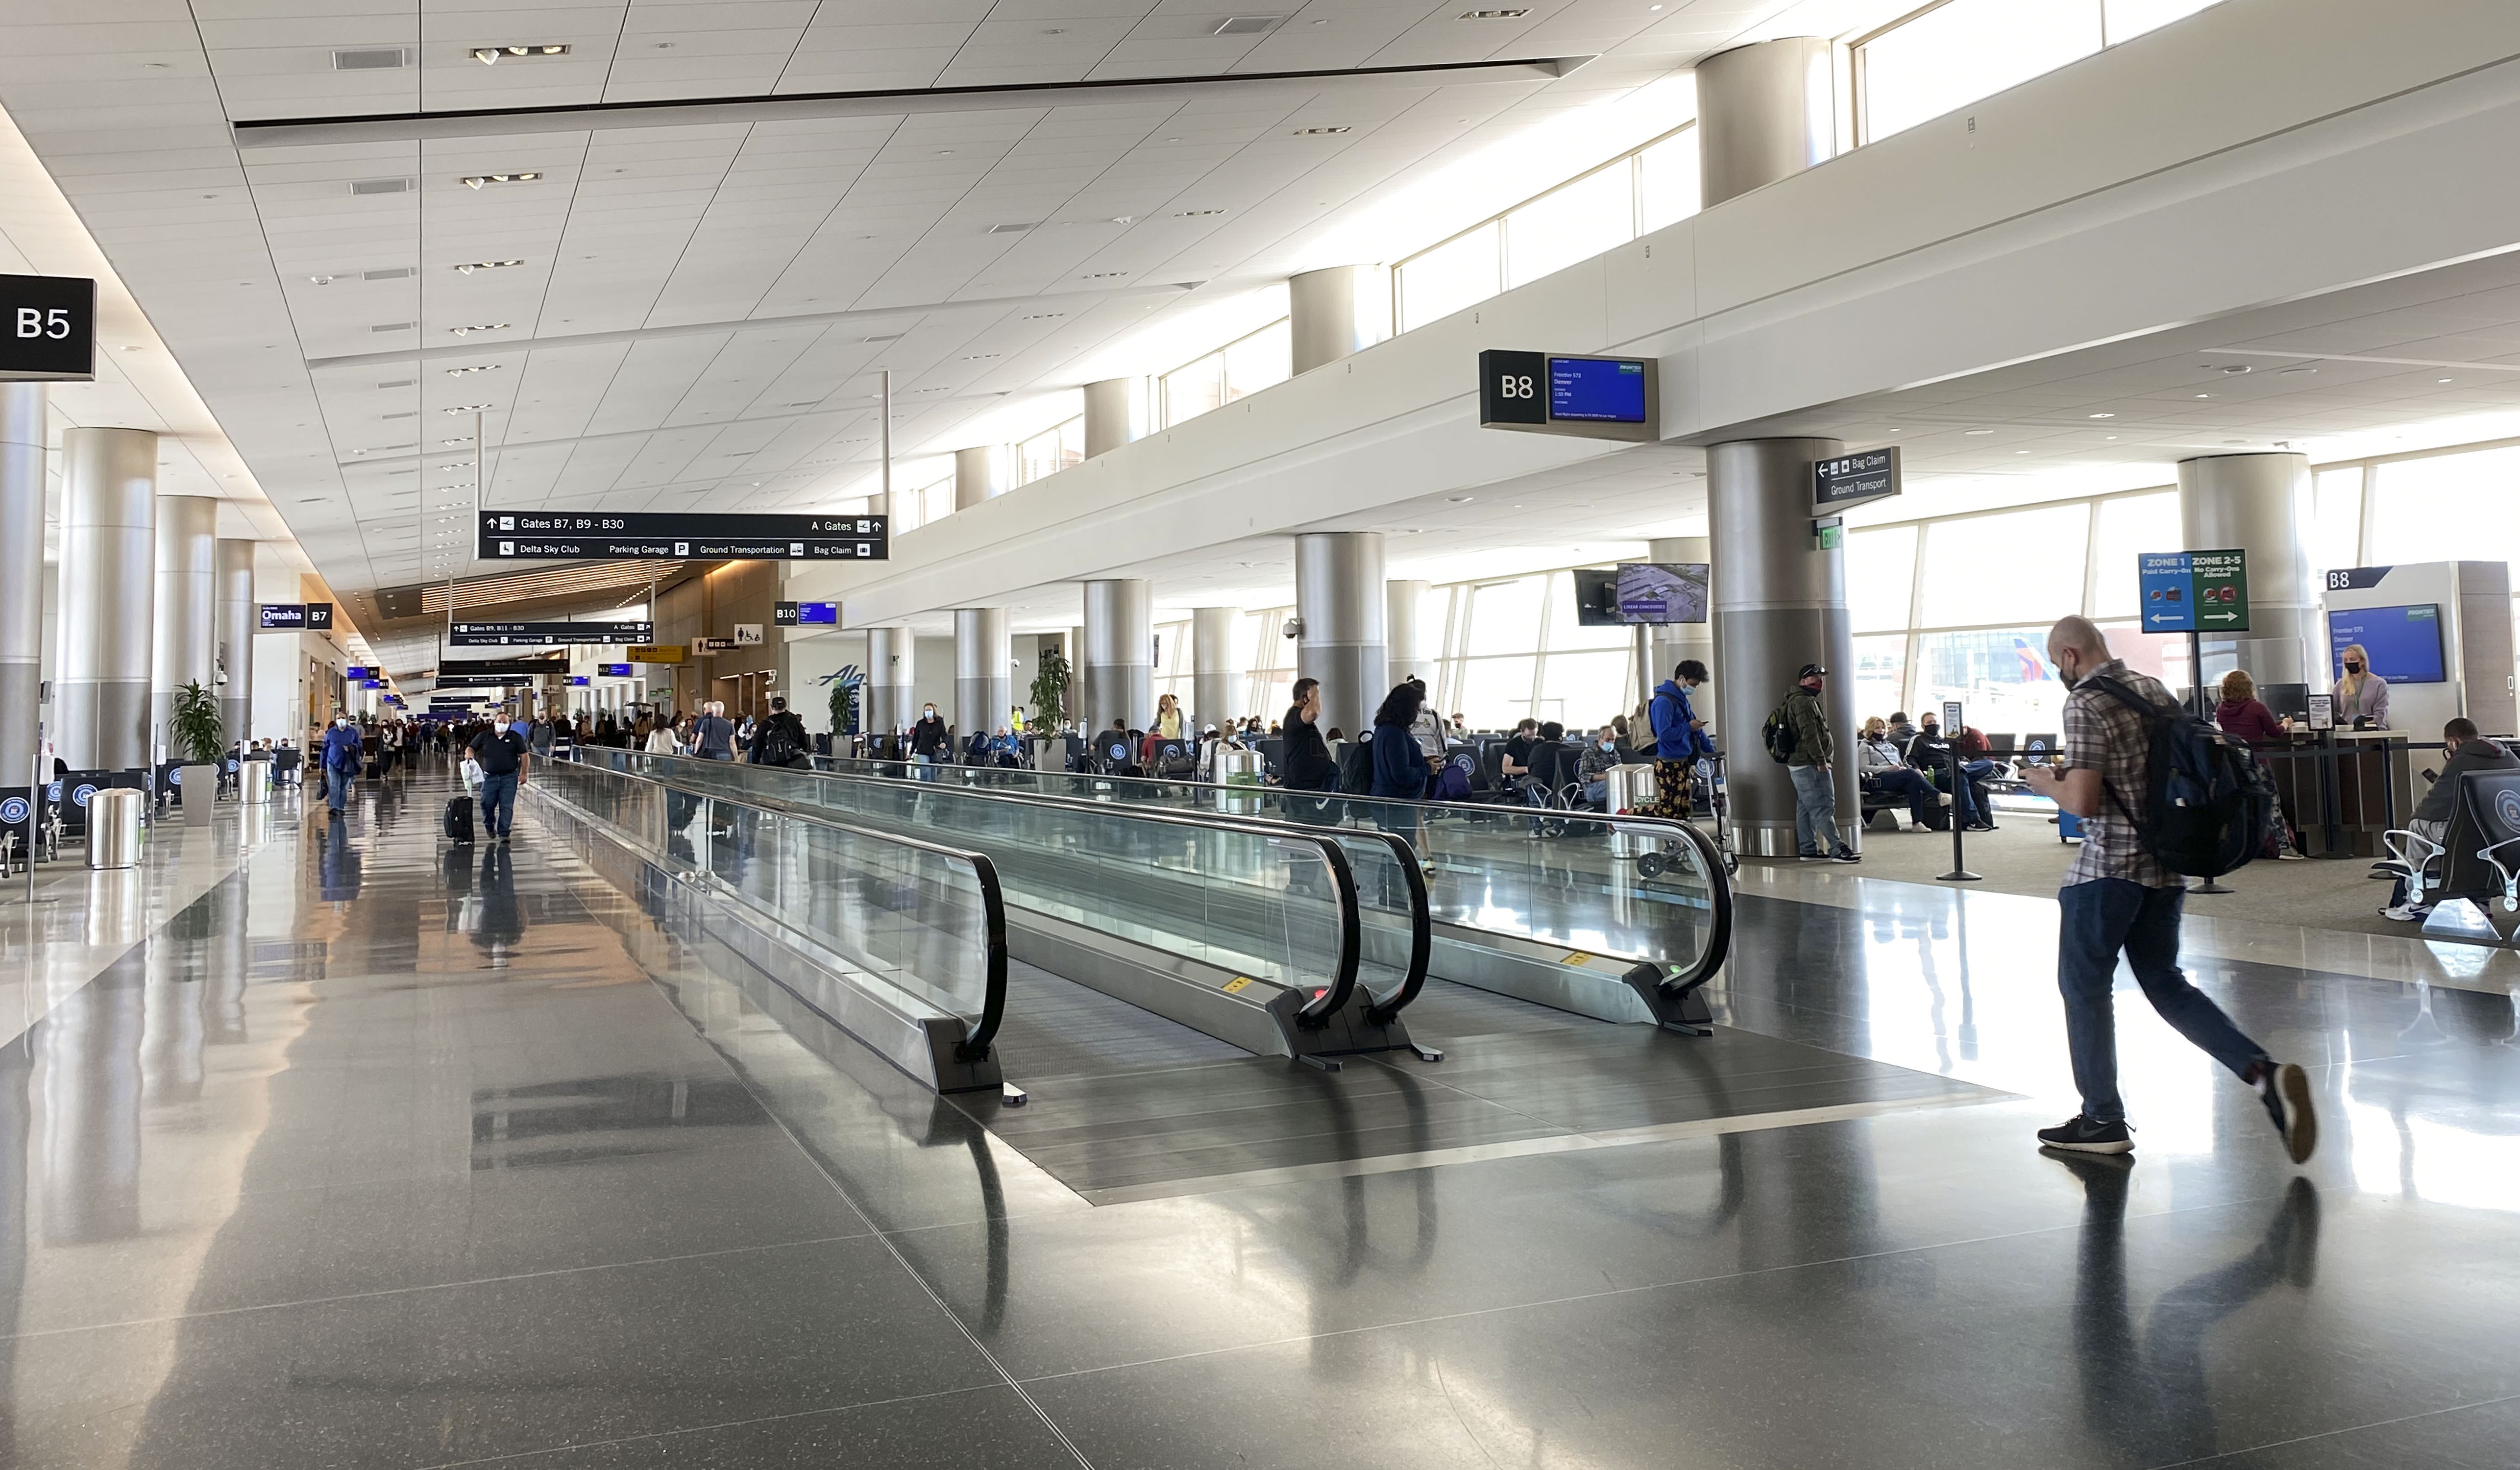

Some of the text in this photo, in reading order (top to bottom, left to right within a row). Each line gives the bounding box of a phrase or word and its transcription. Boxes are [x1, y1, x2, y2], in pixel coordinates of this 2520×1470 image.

[17, 308, 70, 339] B5
[1502, 375, 1533, 398] B8
[1852, 455, 1885, 469] Bag Claim
[1831, 477, 1886, 495] Ground Transport
[521, 518, 550, 529] Gates
[554, 519, 572, 530] B7,
[576, 519, 591, 529] B9
[602, 519, 624, 529] B30
[811, 521, 852, 531] A Gates
[544, 545, 559, 554] Sky
[610, 545, 669, 555] Parking Garage
[730, 546, 784, 555] Transportation
[814, 546, 829, 555] Bag
[2147, 558, 2177, 567] ZONE
[2192, 557, 2222, 565] ZONE
[2330, 572, 2349, 588] B8
[262, 610, 302, 620] Omaha
[312, 611, 327, 621] B7
[777, 609, 796, 618] B10
